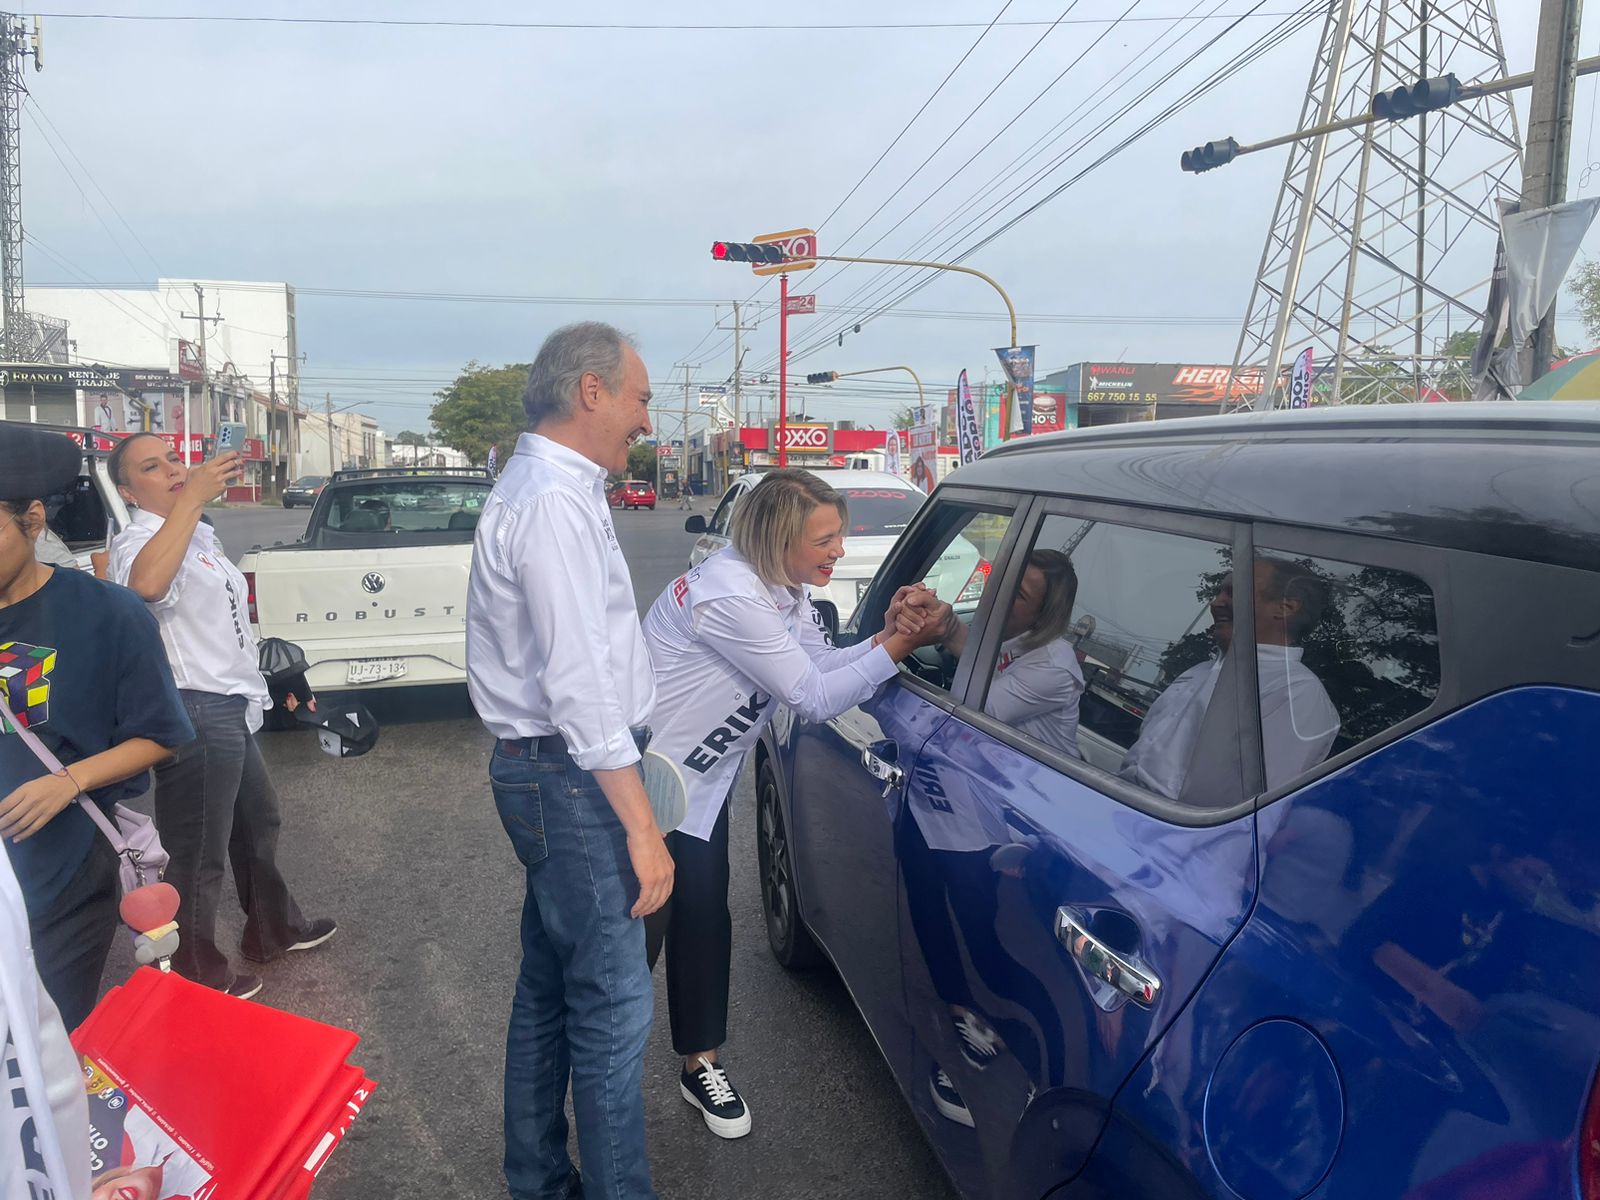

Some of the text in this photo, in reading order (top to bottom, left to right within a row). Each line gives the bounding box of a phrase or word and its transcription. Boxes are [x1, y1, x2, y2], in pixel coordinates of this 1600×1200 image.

[12, 371, 63, 382] FRANCO
[1101, 367, 1136, 375] WANLI
[1087, 392, 1158, 401] 667 750 15 55
[776, 428, 827, 448] OXXO
[296, 605, 454, 622] ROBUST
